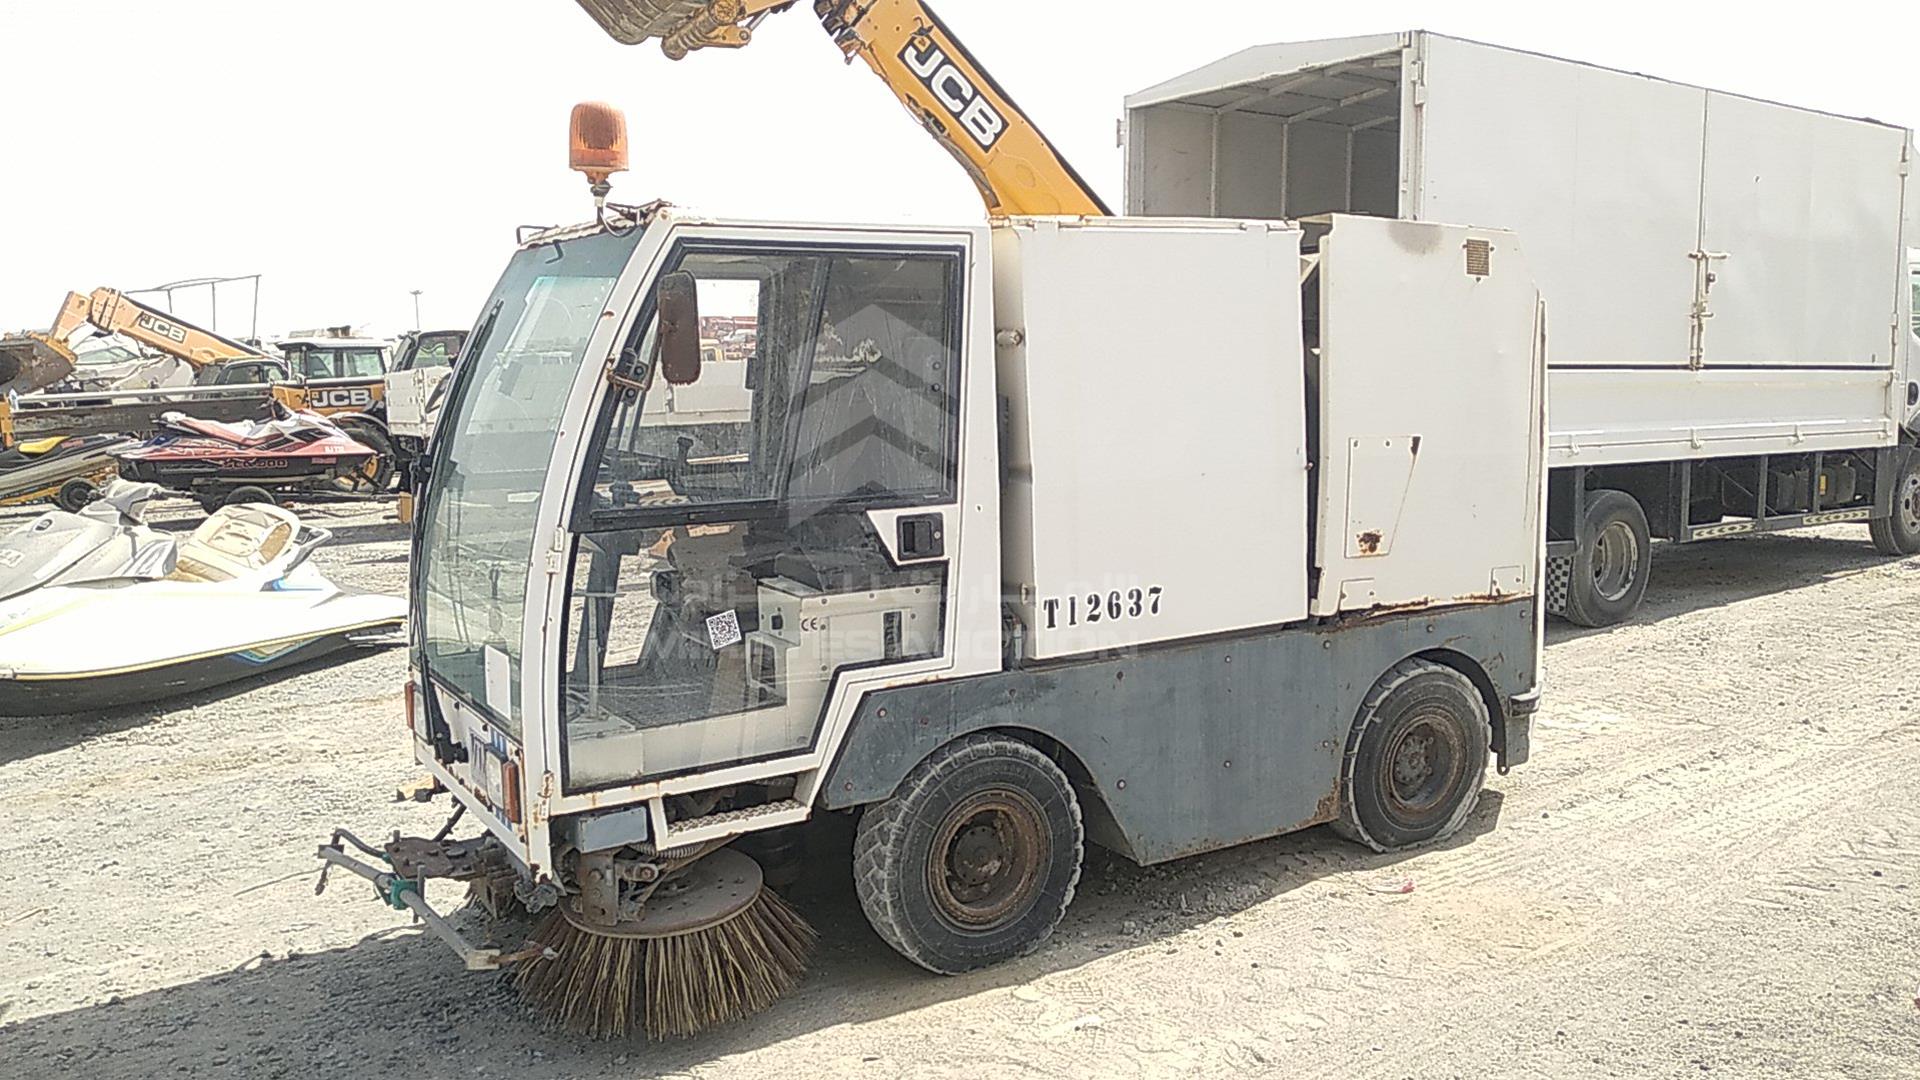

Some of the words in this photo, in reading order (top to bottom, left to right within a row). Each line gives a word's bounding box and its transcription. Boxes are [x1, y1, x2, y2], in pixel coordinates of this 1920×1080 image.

[903, 45, 1003, 146] JCB
[140, 317, 185, 342] JCB
[311, 389, 371, 407] JCB
[1043, 586, 1162, 629] T12637
[801, 617, 818, 632] CE
